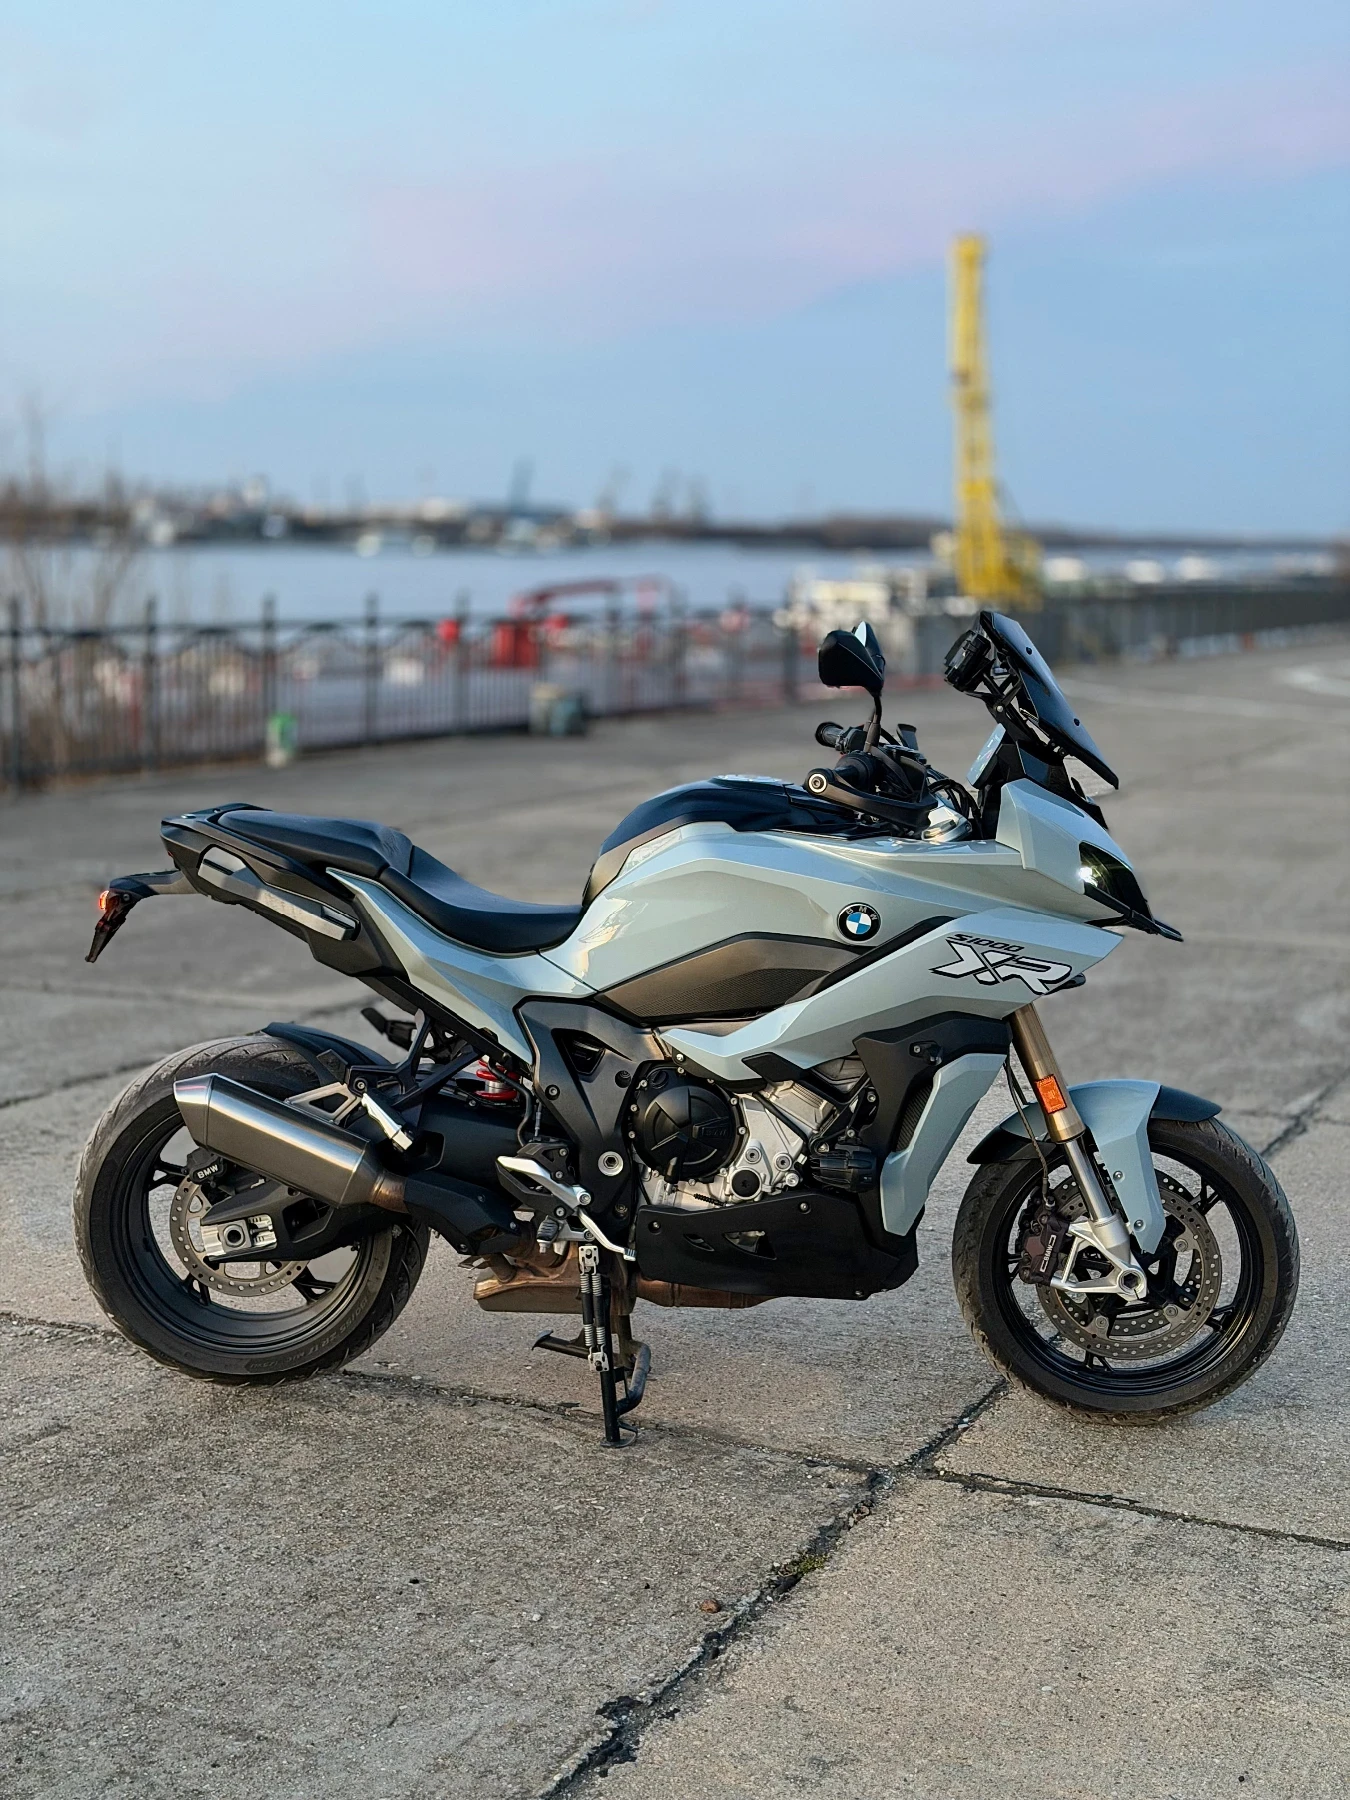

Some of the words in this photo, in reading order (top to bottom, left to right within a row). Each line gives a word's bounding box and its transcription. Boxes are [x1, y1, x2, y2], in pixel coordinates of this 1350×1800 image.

[845, 905, 878, 921] BMW
[947, 933, 1025, 953] S1000
[928, 939, 1073, 996] XR
[197, 1164, 219, 1179] BMW
